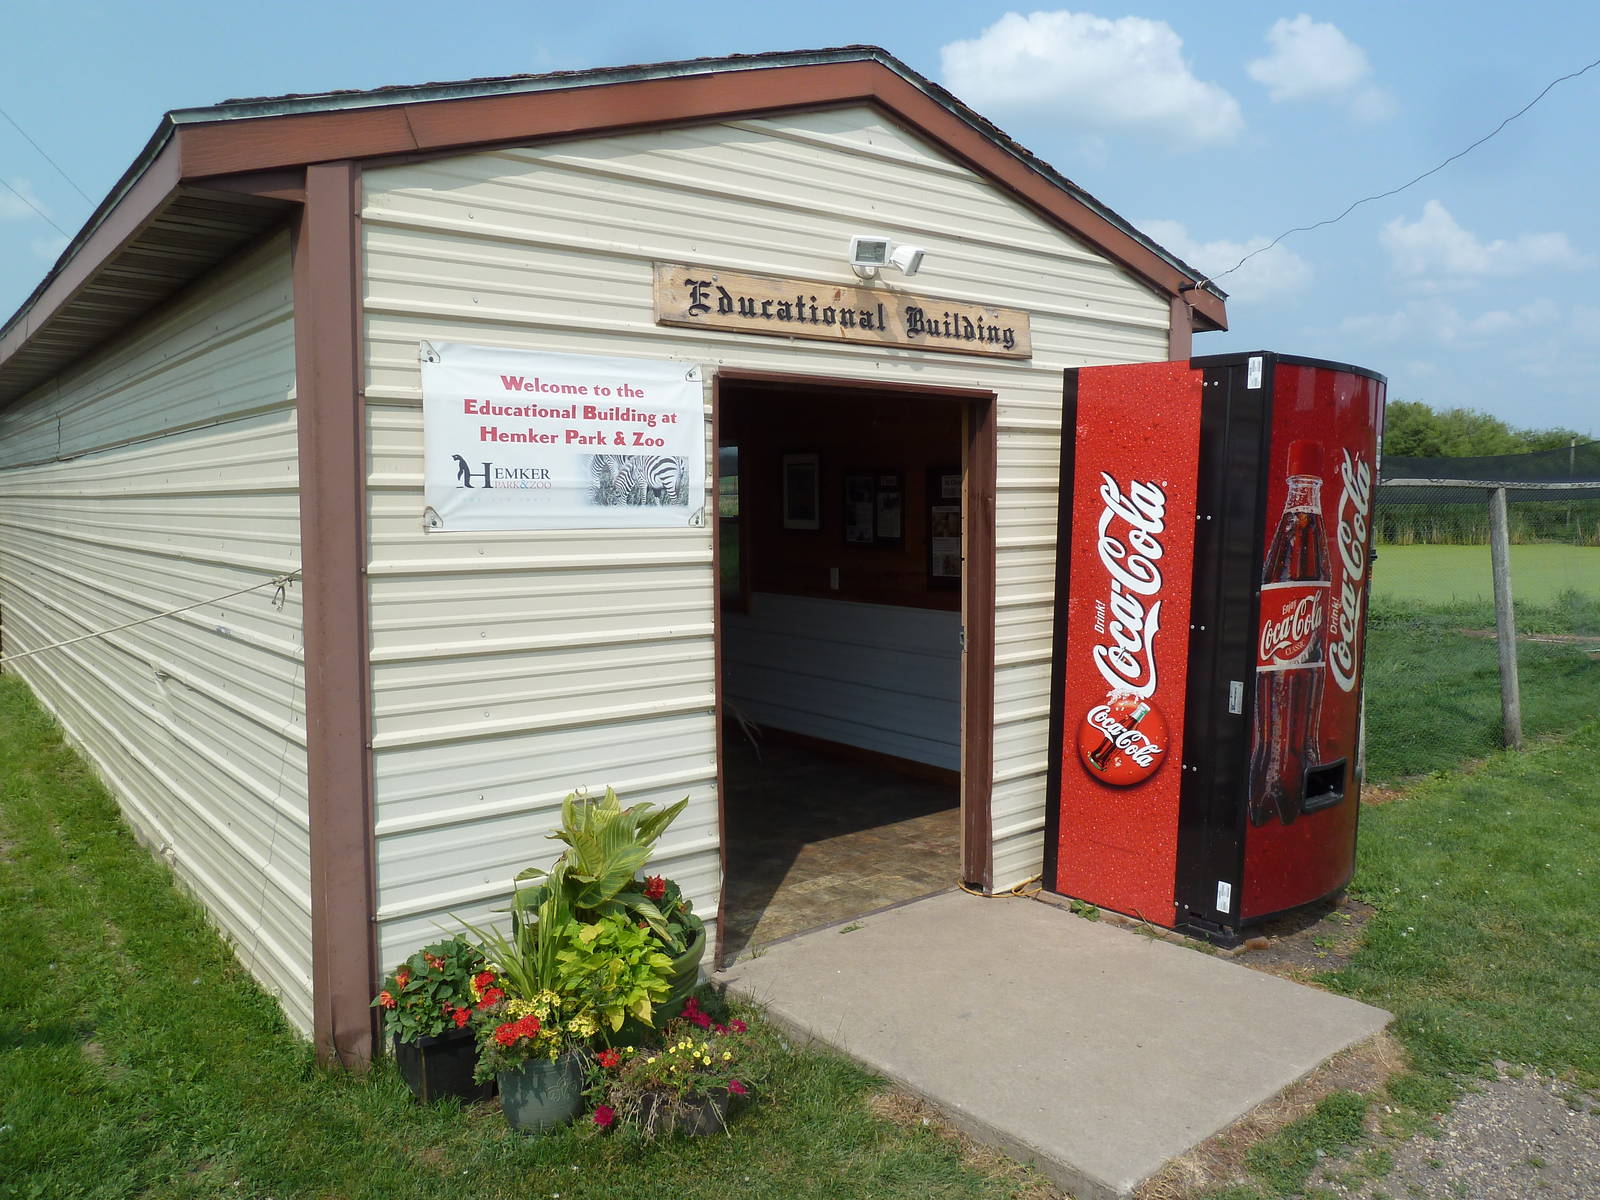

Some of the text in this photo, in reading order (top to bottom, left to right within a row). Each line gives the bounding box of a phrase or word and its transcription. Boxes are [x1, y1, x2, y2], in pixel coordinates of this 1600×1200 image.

[684, 278, 1015, 350] Educational Building
[501, 374, 645, 398] Welcome to the
[463, 398, 678, 427] Educational Building at
[480, 426, 665, 447] Hemker Park & Zoo
[453, 456, 551, 489] HEMKER
[1093, 471, 1167, 699] Coca-Cola
[1330, 447, 1371, 693] Coca-Cola
[1093, 599, 1106, 635] Drink!
[1260, 589, 1322, 661] Coca-Cola
[1282, 599, 1297, 615] Enjoy
[1330, 596, 1341, 635] Drink!
[1087, 705, 1164, 768] Coca-Cola
